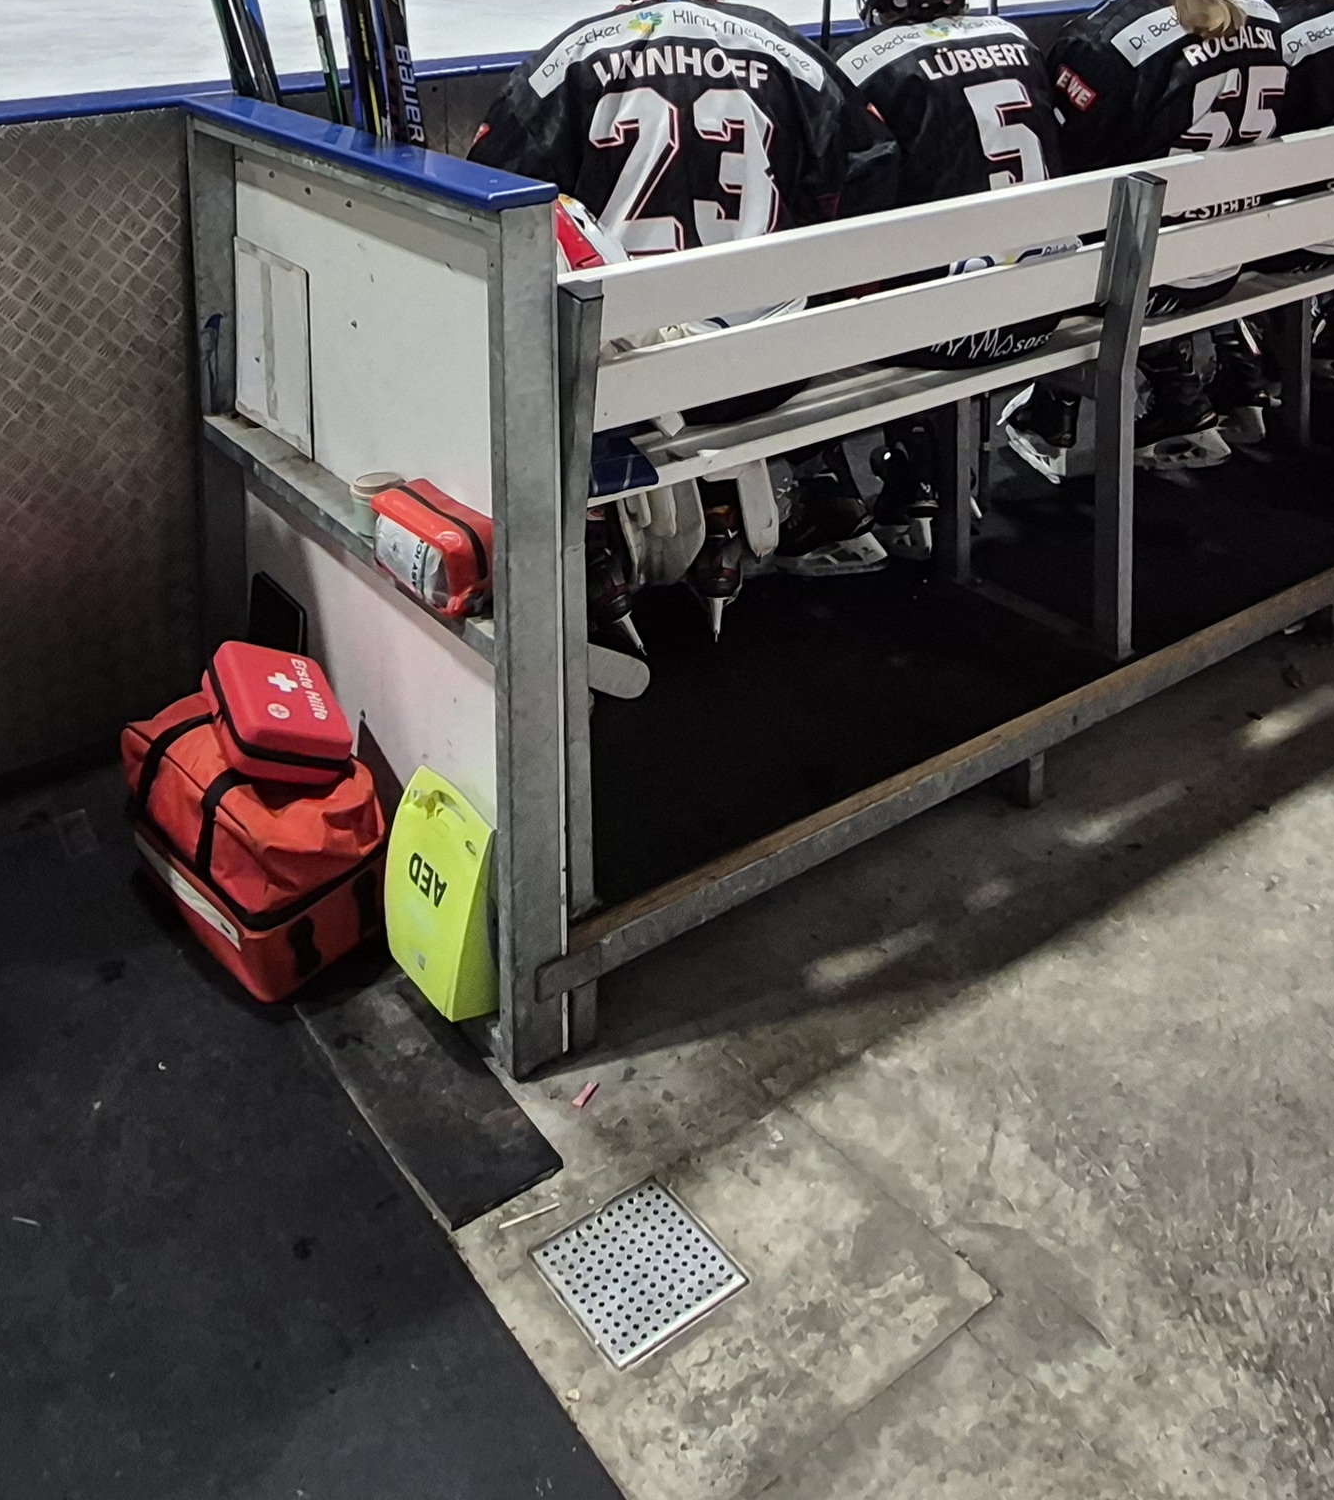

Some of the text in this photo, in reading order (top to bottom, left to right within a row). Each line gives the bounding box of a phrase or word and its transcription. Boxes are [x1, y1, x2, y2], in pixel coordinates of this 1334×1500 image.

[851, 29, 922, 71] Dr. Becker
[918, 43, 1029, 80] LÜBBERT
[1128, 32, 1151, 51] Dr.
[1286, 35, 1308, 54] Dr.
[541, 60, 565, 78] Dr.
[592, 45, 768, 89] LINNHOFF
[1056, 67, 1092, 108] EWE
[964, 78, 1050, 191] 5
[588, 86, 780, 261] 23
[290, 657, 328, 720] Erste Hilfe
[408, 852, 448, 909] AED
